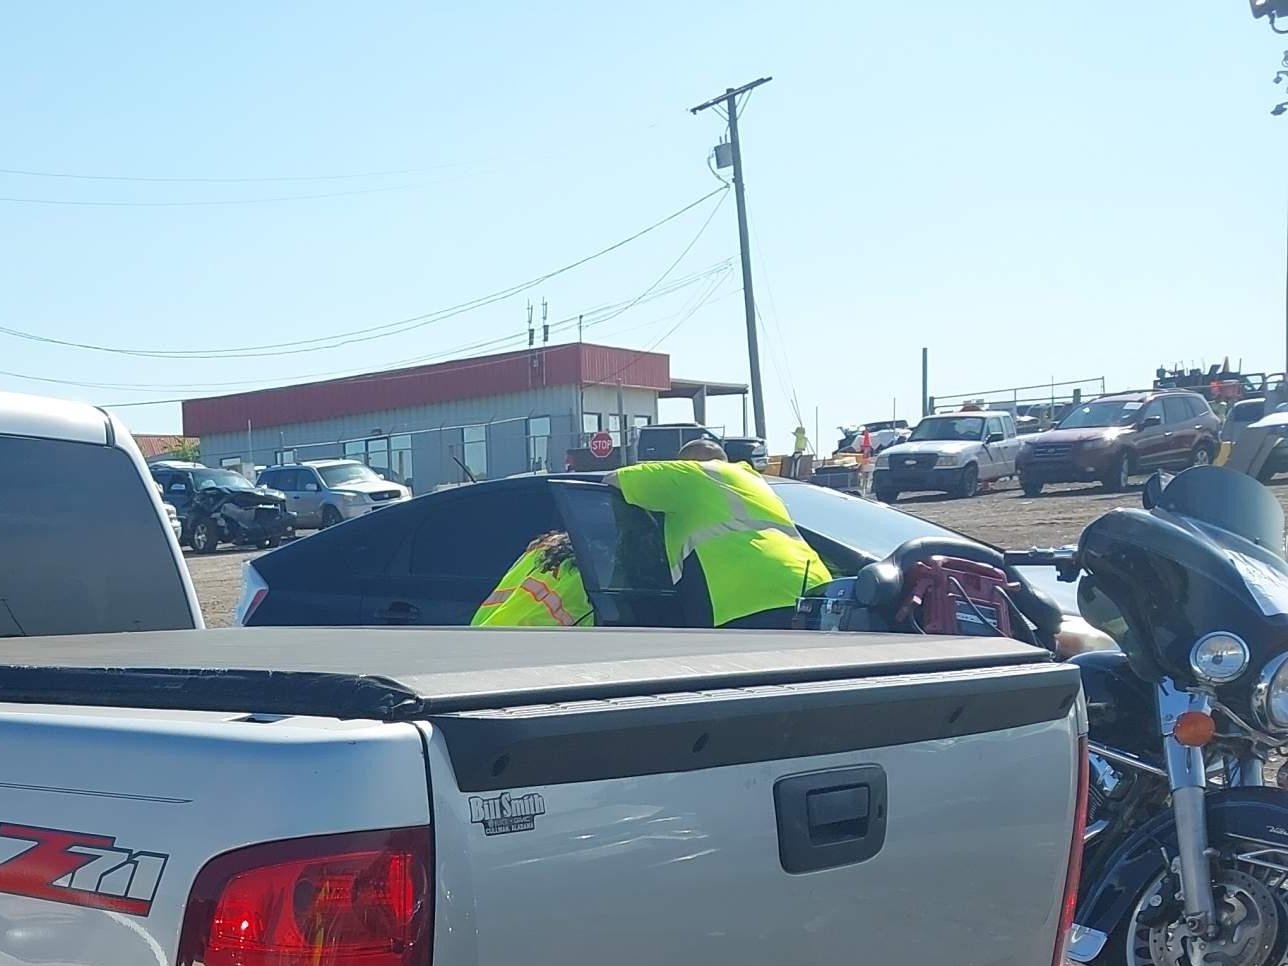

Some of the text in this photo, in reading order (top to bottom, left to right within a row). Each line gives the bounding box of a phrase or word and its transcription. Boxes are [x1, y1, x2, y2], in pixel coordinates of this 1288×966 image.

[592, 440, 612, 450] STOP
[470, 792, 545, 822] Bill Smith
